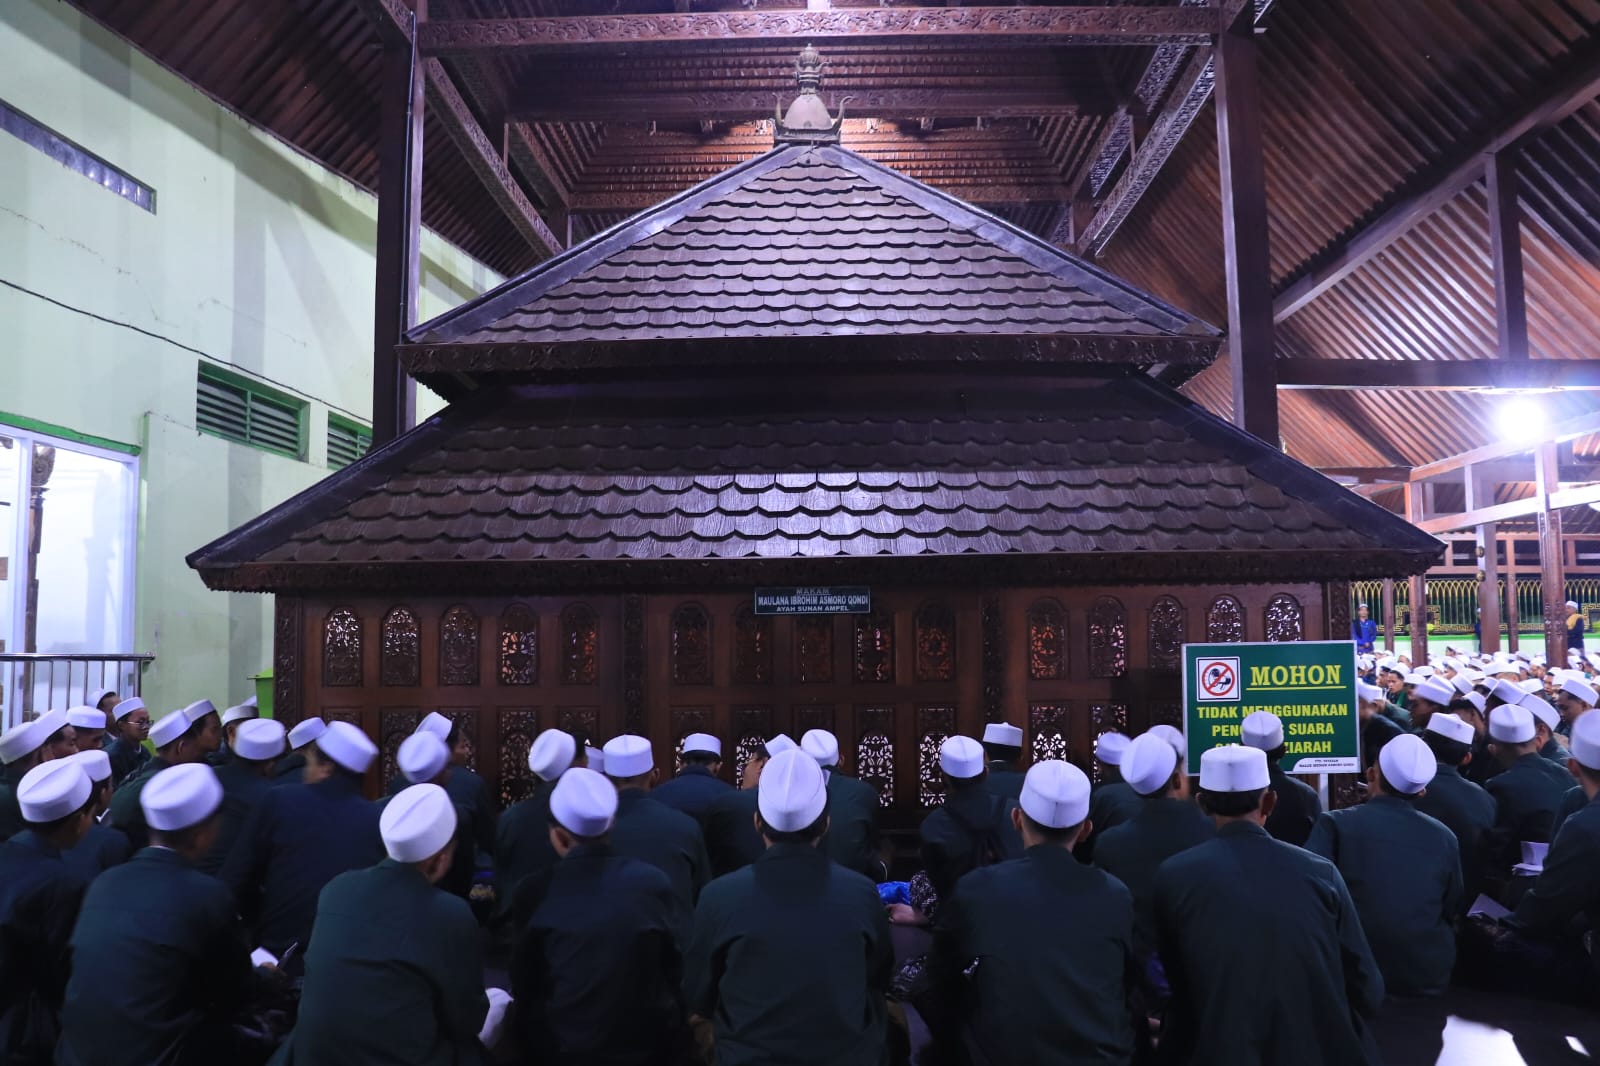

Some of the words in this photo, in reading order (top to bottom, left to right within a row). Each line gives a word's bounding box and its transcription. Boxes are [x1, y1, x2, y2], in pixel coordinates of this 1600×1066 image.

[758, 596, 789, 606] MAULANA
[790, 596, 818, 605] IBROHIM
[819, 595, 847, 605] ASMORO
[848, 595, 868, 604] QONDI
[1250, 664, 1341, 686] MOHON
[1197, 706, 1238, 719] TIDAK
[1288, 723, 1335, 736] SUARA
